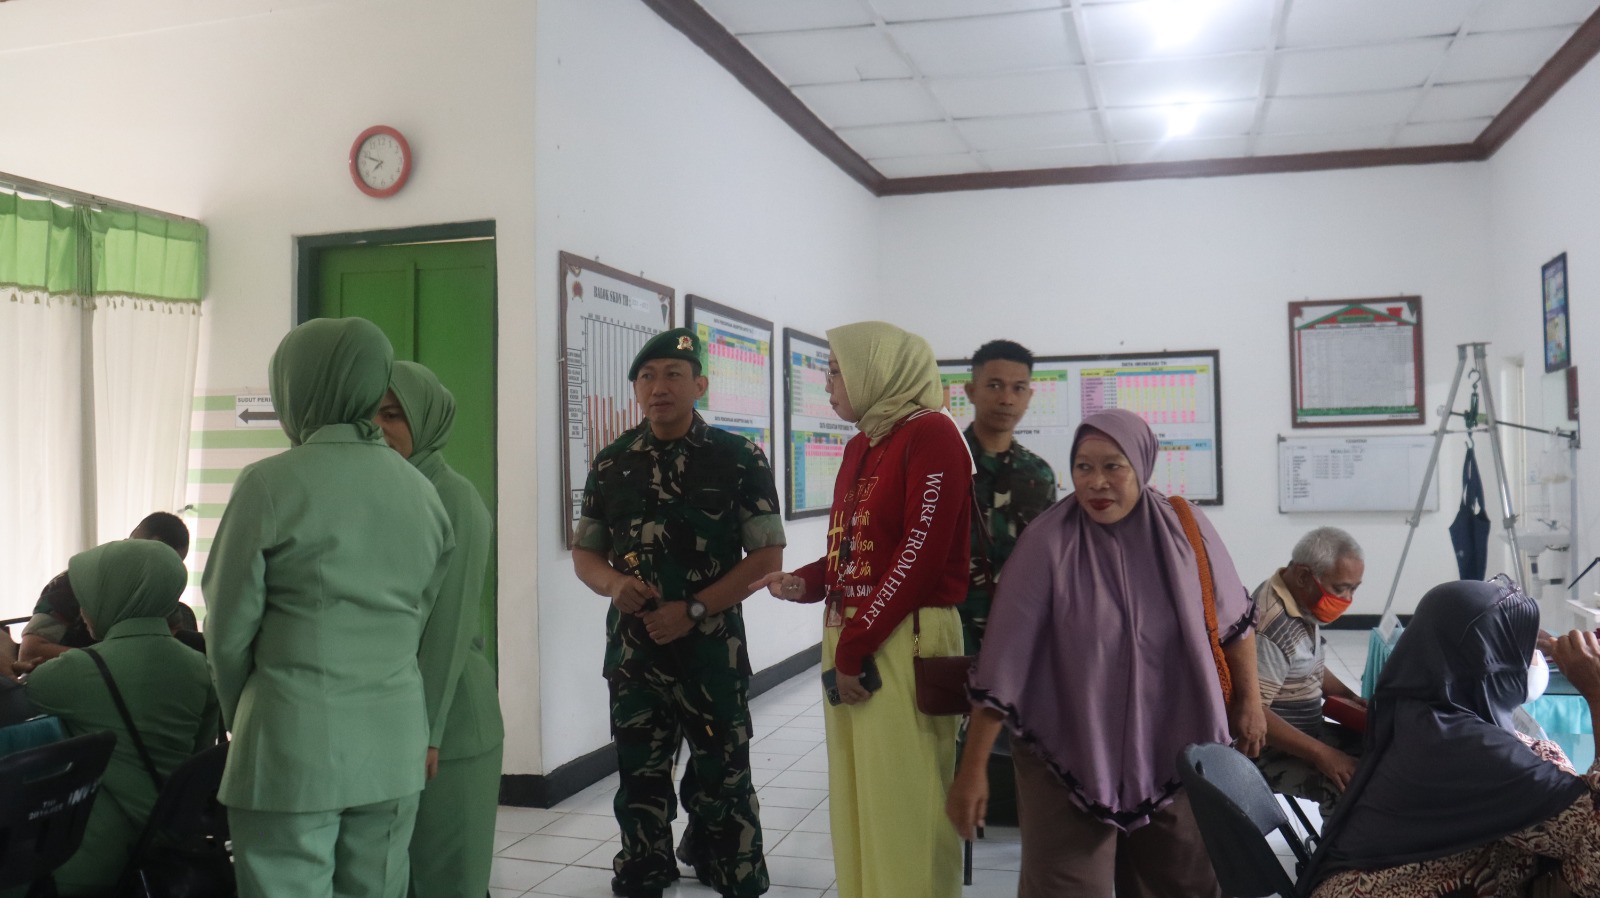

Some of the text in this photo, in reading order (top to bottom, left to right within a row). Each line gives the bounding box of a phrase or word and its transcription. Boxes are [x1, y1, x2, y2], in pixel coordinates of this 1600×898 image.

[862, 472, 944, 630] WORK FROM HEART
